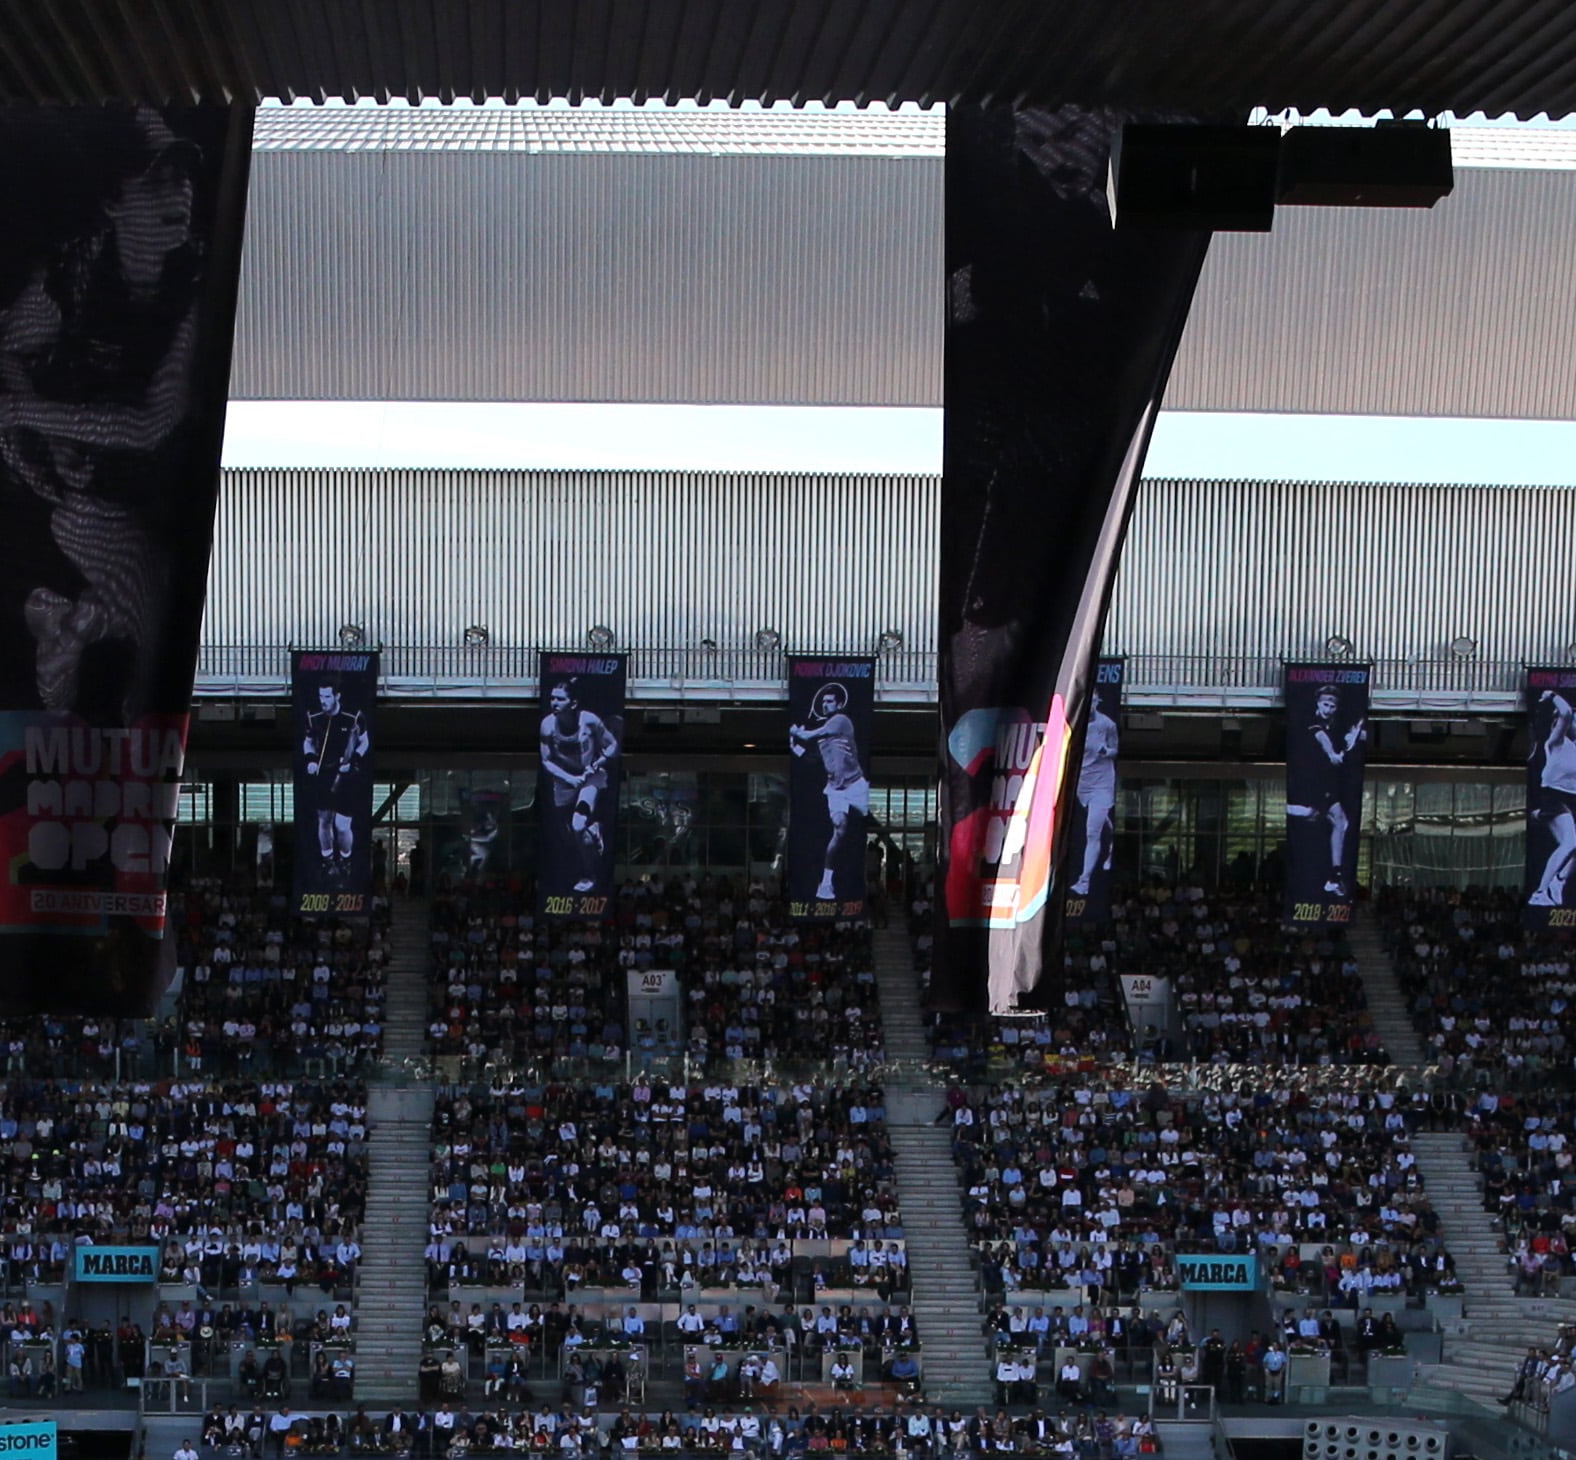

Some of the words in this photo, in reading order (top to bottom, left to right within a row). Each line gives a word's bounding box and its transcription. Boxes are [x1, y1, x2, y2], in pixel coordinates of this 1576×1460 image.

[327, 655, 370, 671] MURRAY
[587, 659, 618, 674] HALEP
[824, 663, 872, 678] DJOKOVIC
[1097, 664, 1122, 684] ENS
[25, 727, 185, 777] MUTUA
[62, 896, 165, 914] ANIVERSAR
[336, 894, 365, 912] 2015
[545, 896, 574, 914] 2016
[580, 897, 608, 915] 2017
[1293, 903, 1322, 921] 2018
[1326, 905, 1352, 923] 2021
[1548, 908, 1576, 926] 2021
[642, 975, 662, 986] A03
[1132, 979, 1151, 991] A04
[83, 1253, 153, 1276] MARCA
[1180, 1262, 1248, 1284] MARCA
